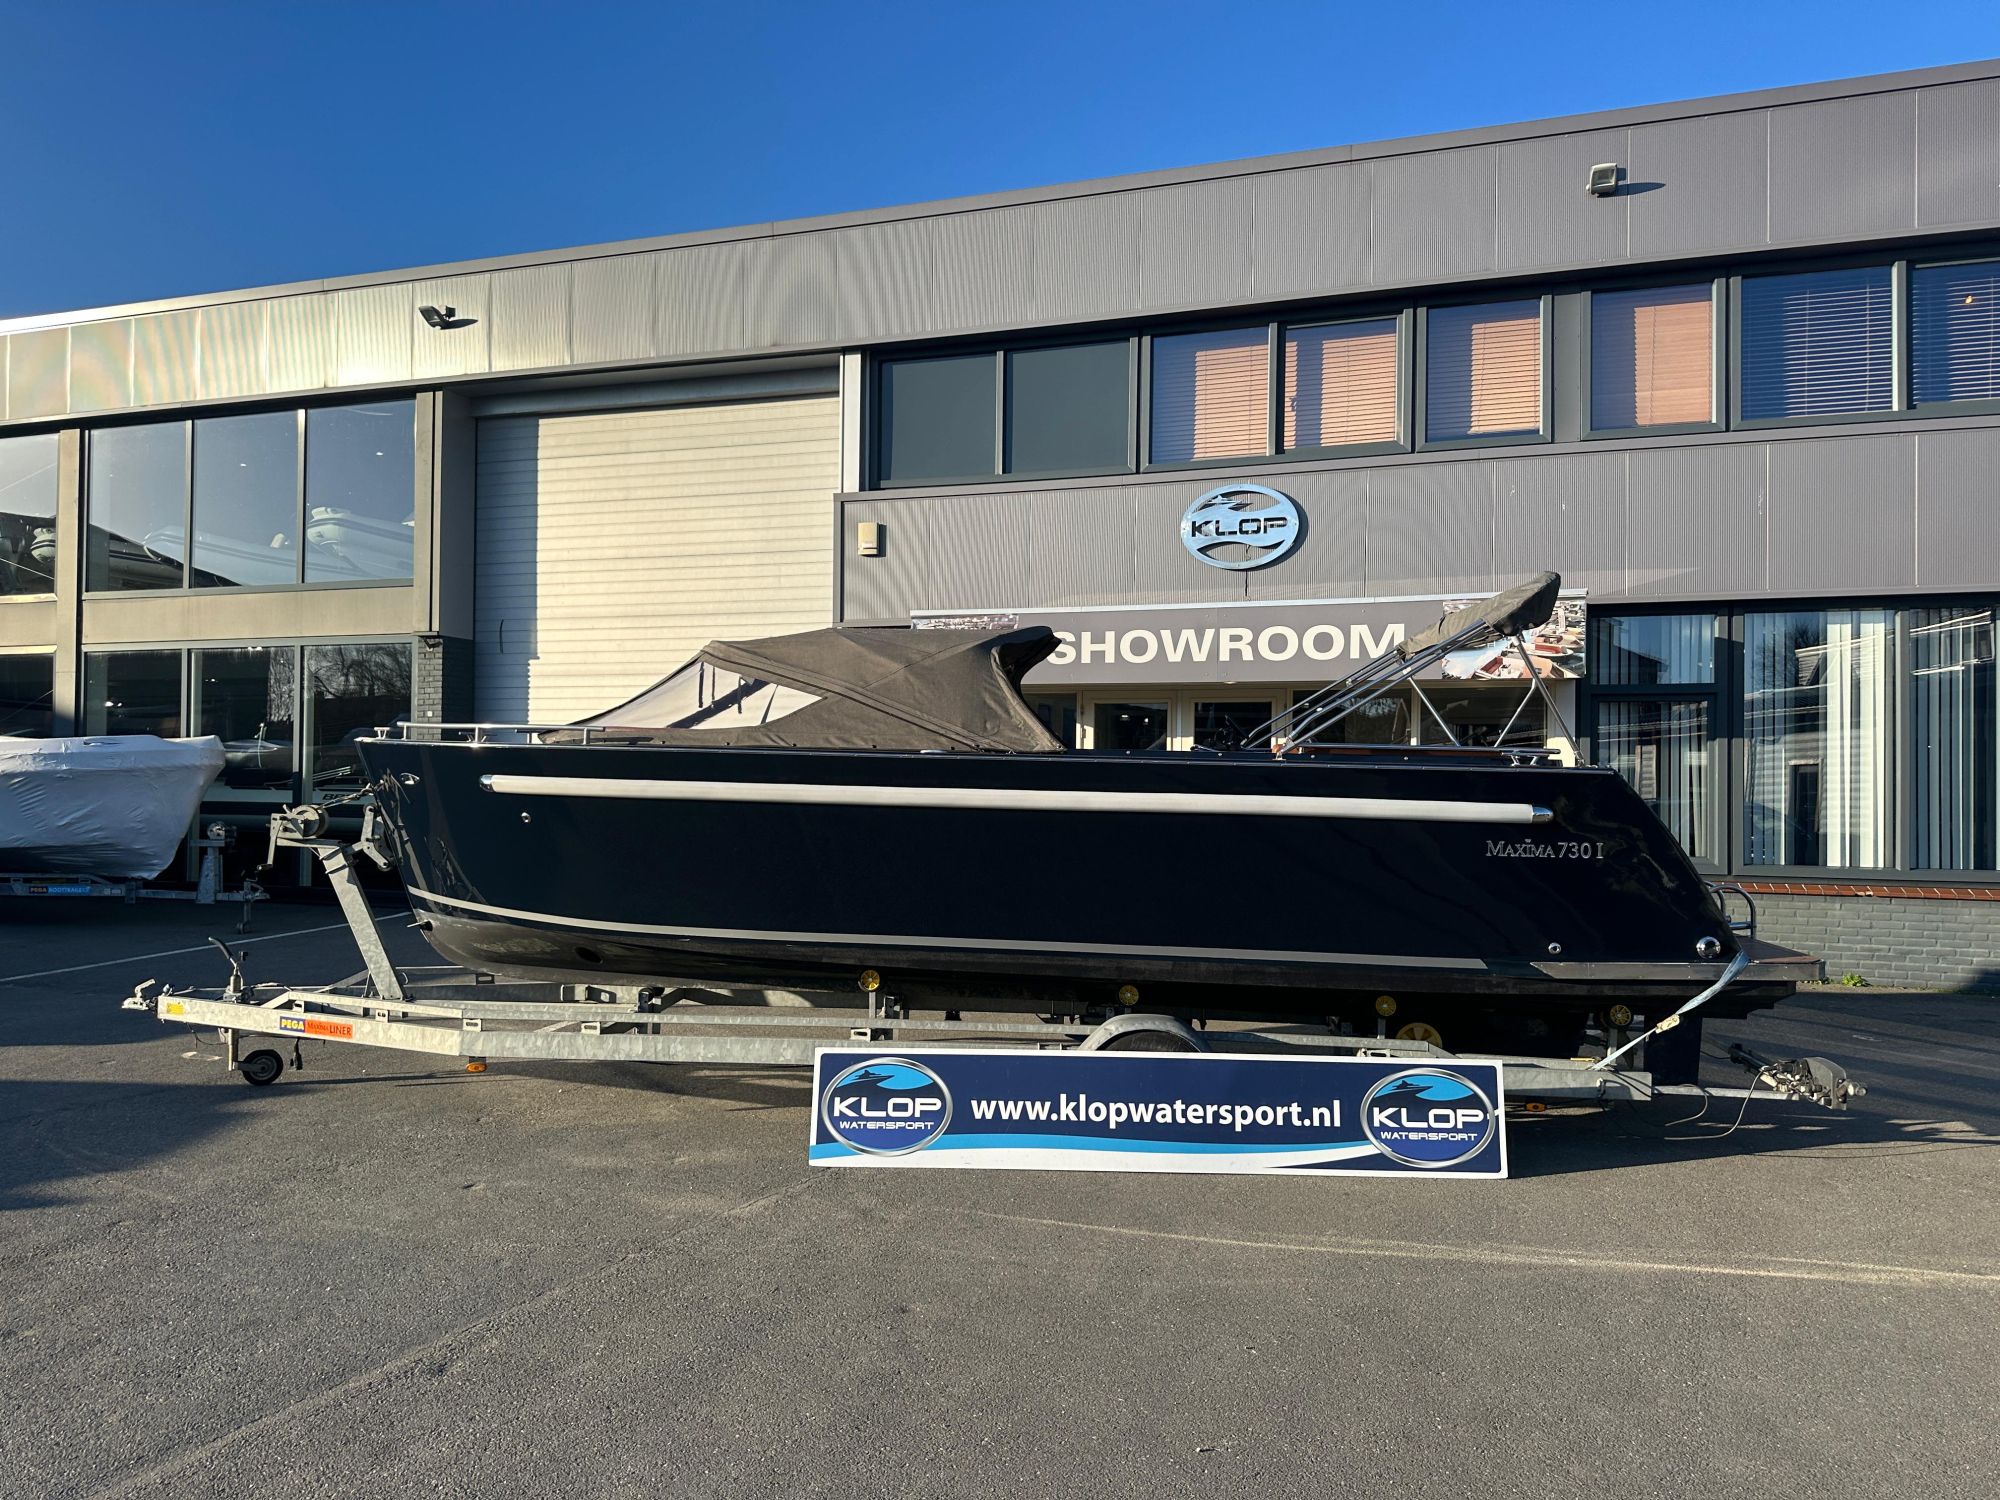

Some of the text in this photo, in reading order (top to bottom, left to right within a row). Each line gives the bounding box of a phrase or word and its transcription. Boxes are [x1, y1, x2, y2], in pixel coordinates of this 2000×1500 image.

[1191, 516, 1288, 537] KLOP
[1046, 623, 1405, 665] SHOWROOM
[1557, 841, 1592, 859] 730
[1595, 842, 1604, 859] I
[281, 1018, 305, 1030] PEGA
[329, 1024, 352, 1036] LINER
[833, 1096, 942, 1118] KLOP
[970, 1093, 1342, 1132] www.klopwatersport.nl
[1373, 1106, 1485, 1129] KLOP
[840, 1121, 934, 1130] WATERSPORT
[1380, 1131, 1478, 1141] WATERSPORT
